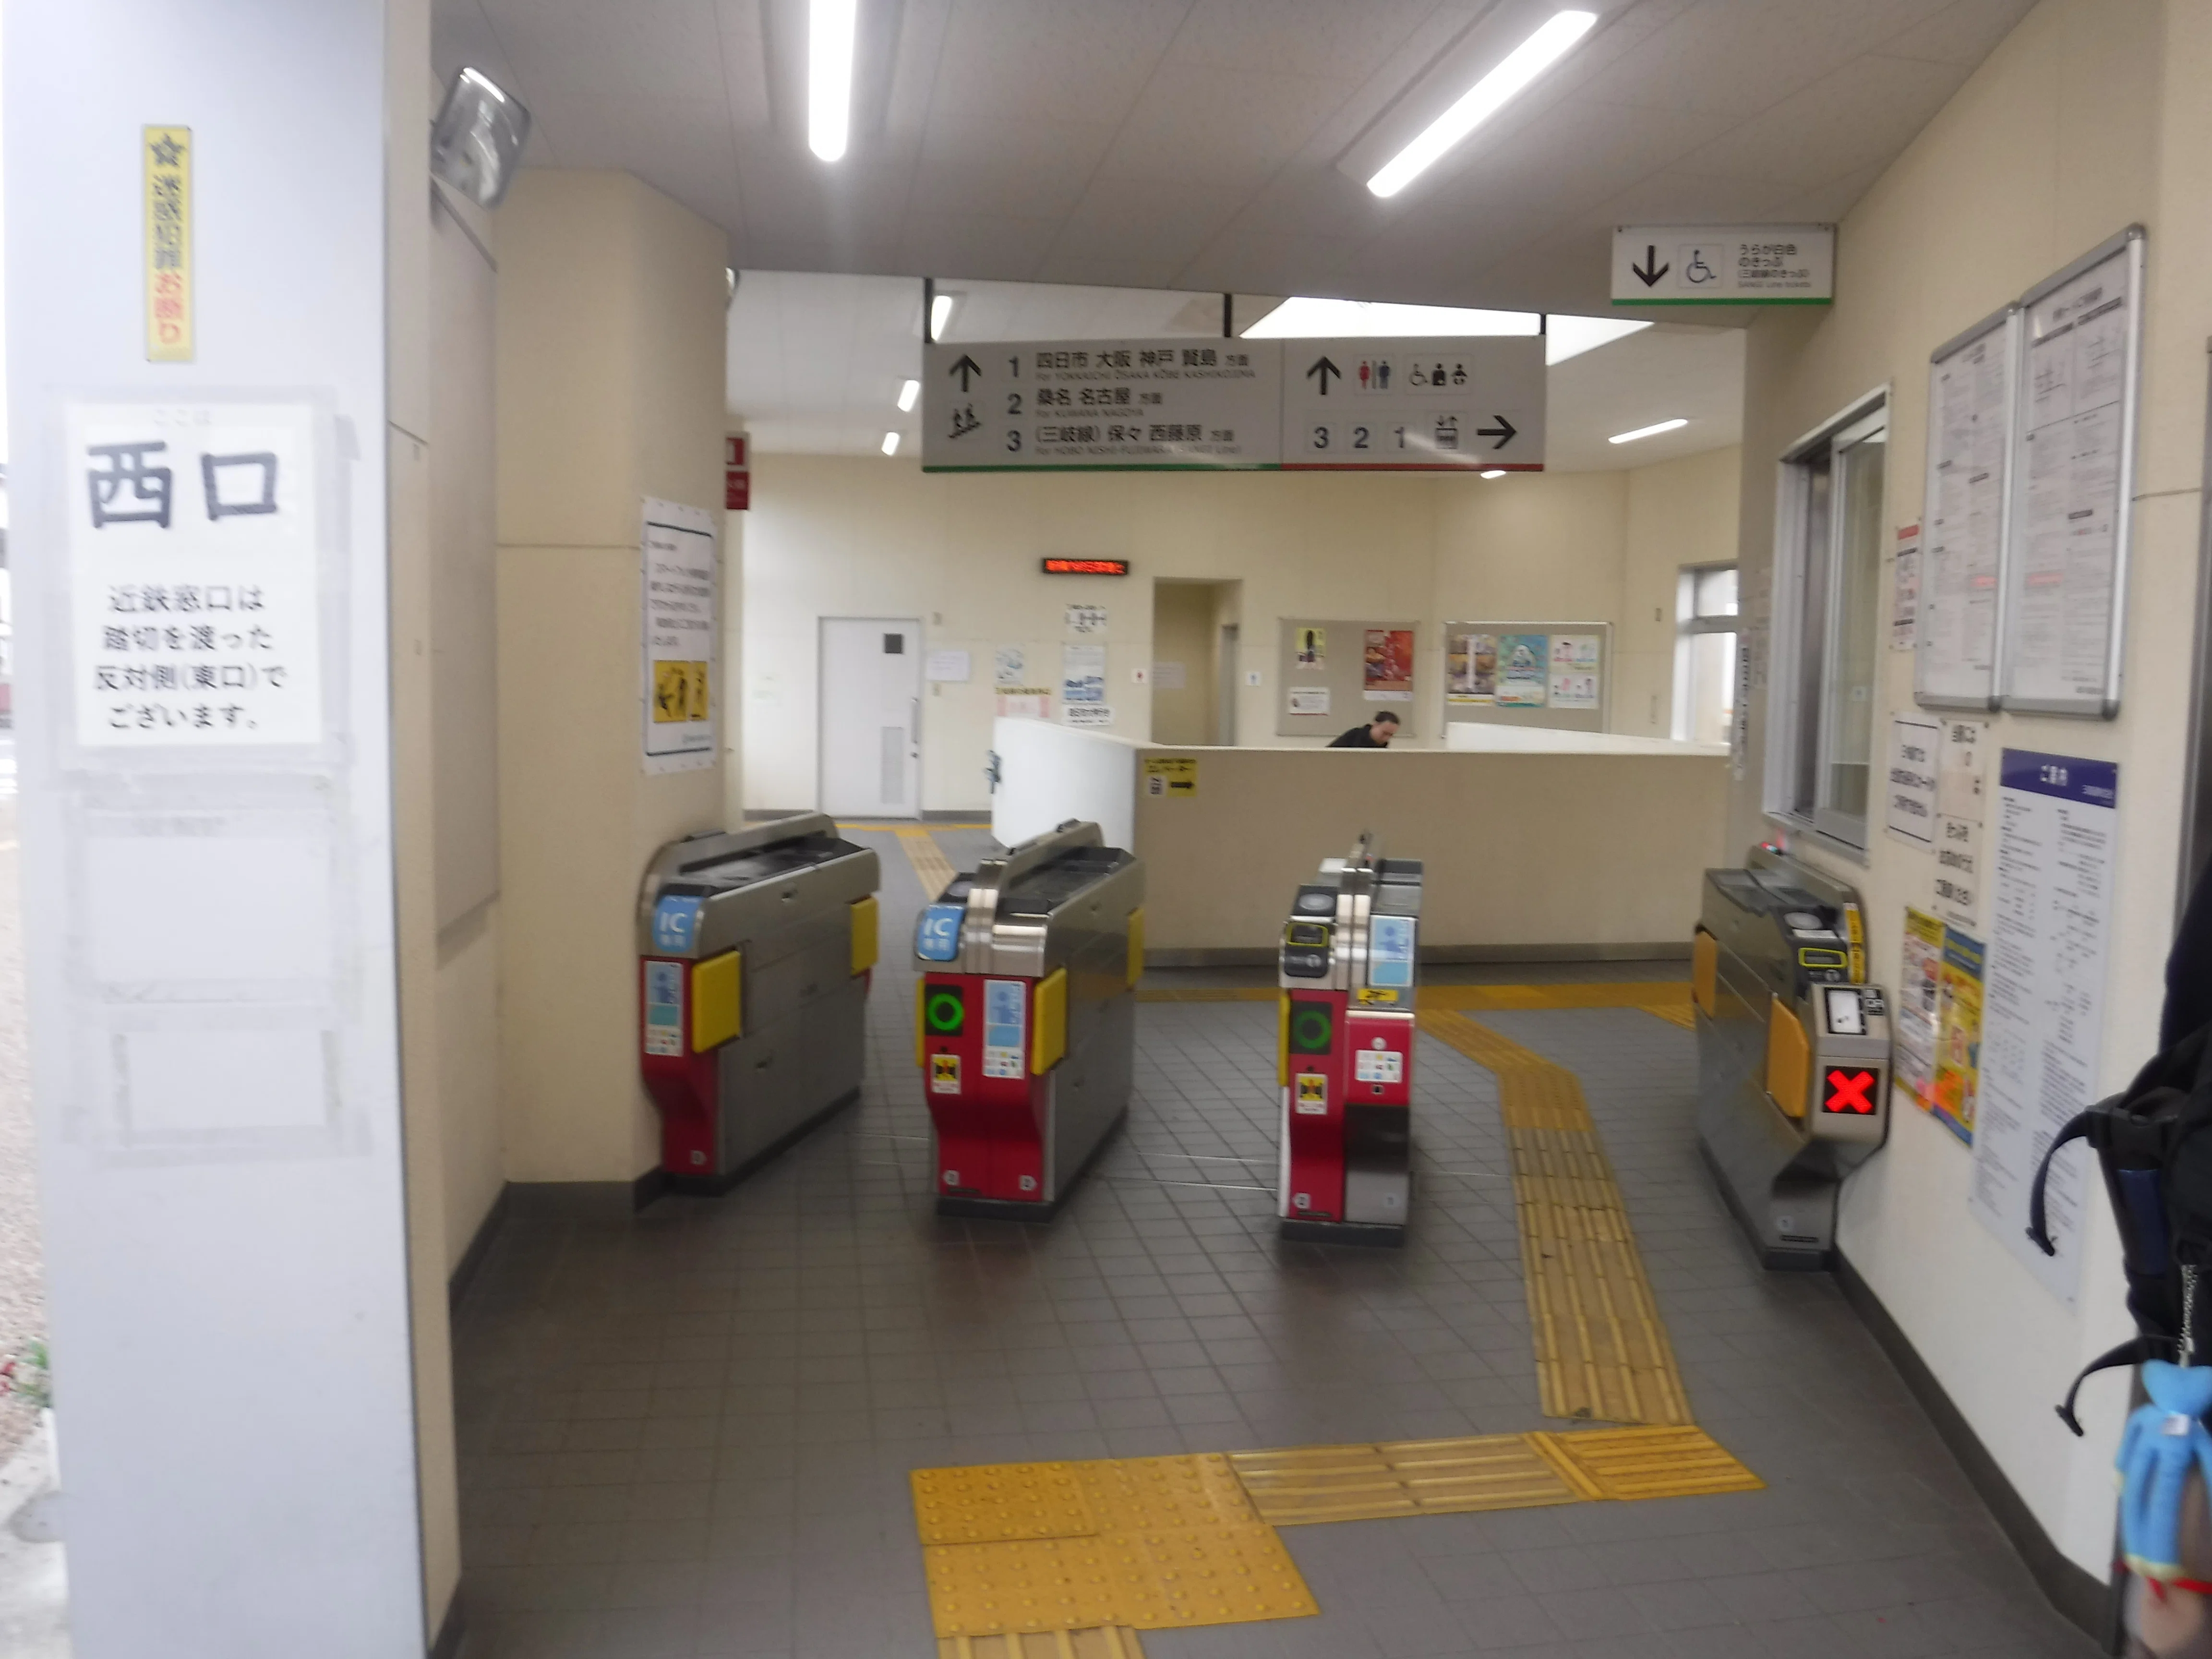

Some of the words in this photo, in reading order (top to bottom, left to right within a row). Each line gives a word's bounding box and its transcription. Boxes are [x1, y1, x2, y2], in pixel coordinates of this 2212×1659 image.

[1009, 357, 1019, 378] 1
[1037, 351, 1088, 368] 四日市
[1096, 350, 1131, 367] 大阪
[1140, 349, 1174, 367] 神戸
[1182, 349, 1216, 366] 賢島
[1008, 394, 1022, 415] 2
[1036, 388, 1071, 405] 桑名
[1079, 387, 1130, 405] 名古屋
[1007, 431, 1022, 452] 3
[1149, 424, 1202, 441] 西藤原
[1314, 426, 1330, 449] 3
[1355, 426, 1370, 449] 2
[1395, 426, 1405, 448] 1
[87, 440, 278, 529] 西口
[108, 584, 265, 613] 近鉄窓口は
[103, 625, 273, 650] 踏切を渡った
[95, 664, 288, 690] 反対側(東口)で
[108, 703, 258, 729] ございます。
[660, 913, 687, 933] IC
[924, 918, 953, 936] IC
